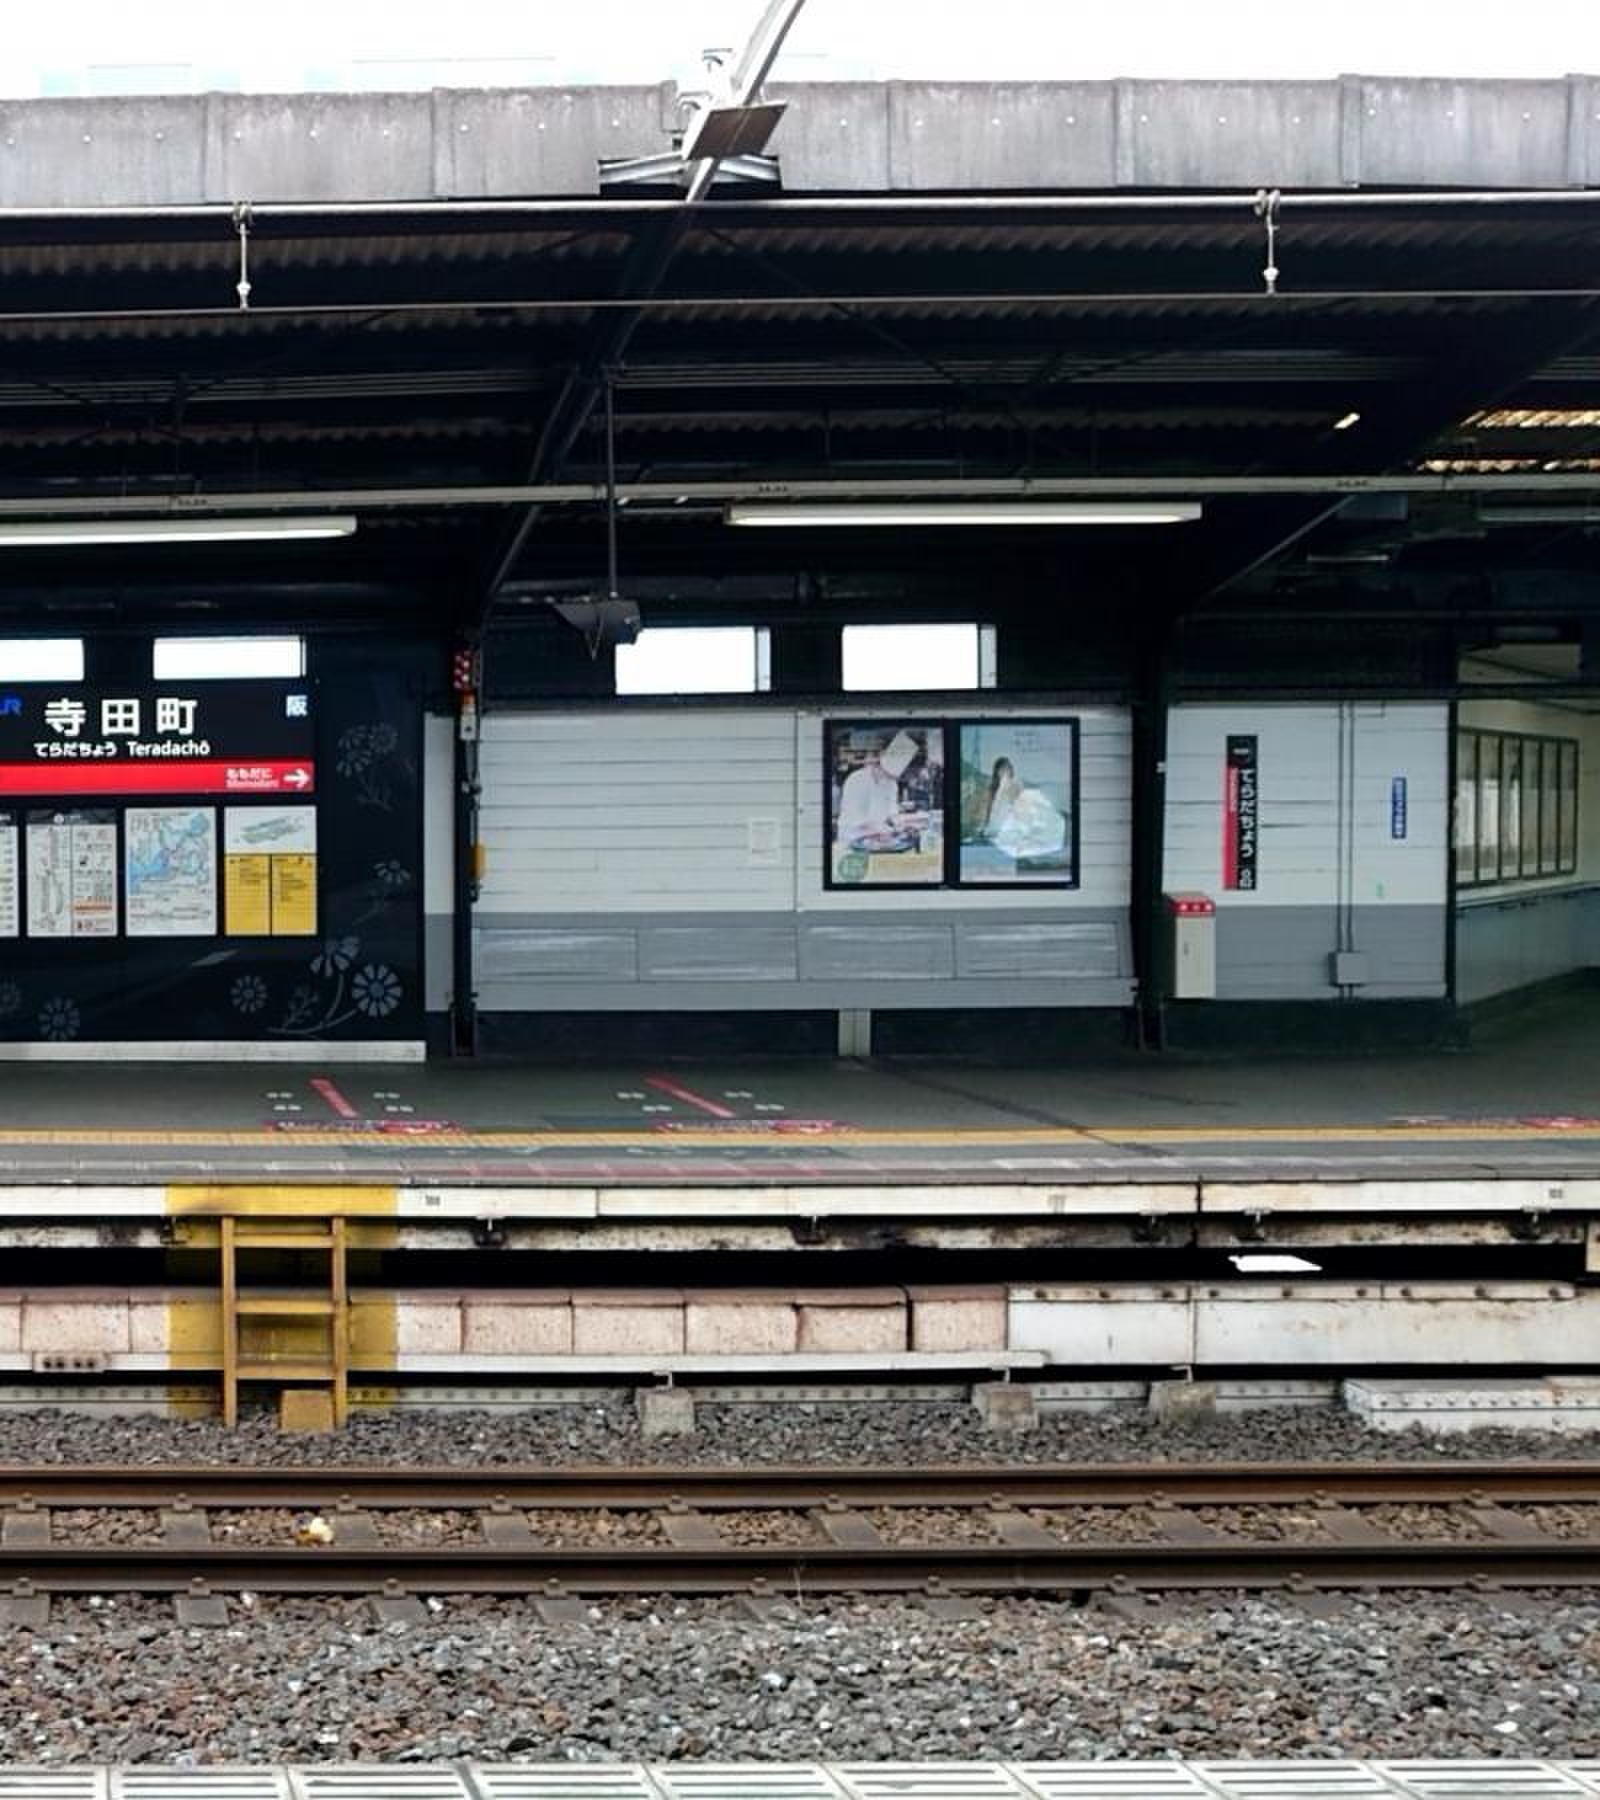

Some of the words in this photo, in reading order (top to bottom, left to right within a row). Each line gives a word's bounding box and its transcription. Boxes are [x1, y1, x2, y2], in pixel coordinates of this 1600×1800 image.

[44, 697, 198, 736] 寺田町
[33, 741, 118, 758] てらだちょう
